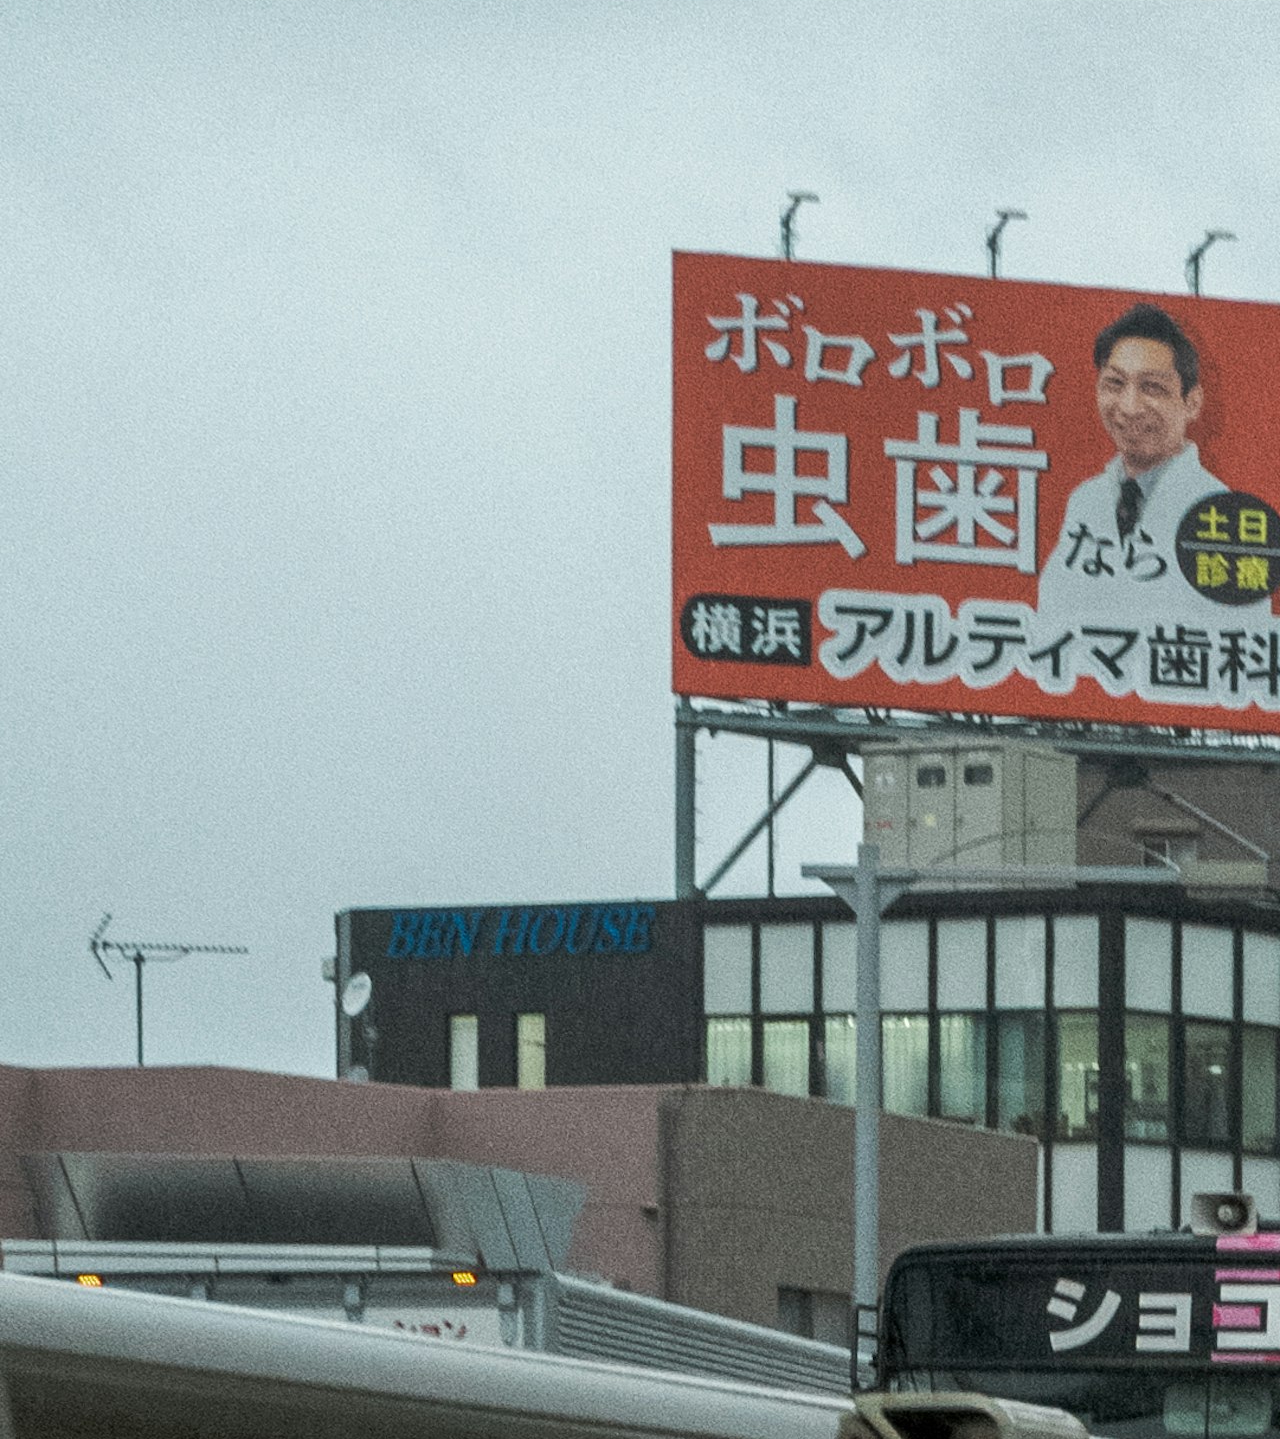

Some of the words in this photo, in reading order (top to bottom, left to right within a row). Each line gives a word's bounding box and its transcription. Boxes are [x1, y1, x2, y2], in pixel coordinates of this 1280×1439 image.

[705, 292, 1056, 407] ボロボロ
[708, 394, 1049, 575] 虫歯
[1064, 522, 1170, 583] なら
[1196, 505, 1268, 545] 土日
[1194, 553, 1270, 593] 診療
[691, 601, 803, 657] 横浜
[386, 912, 481, 958] BEN
[492, 905, 656, 956] HOUSE
